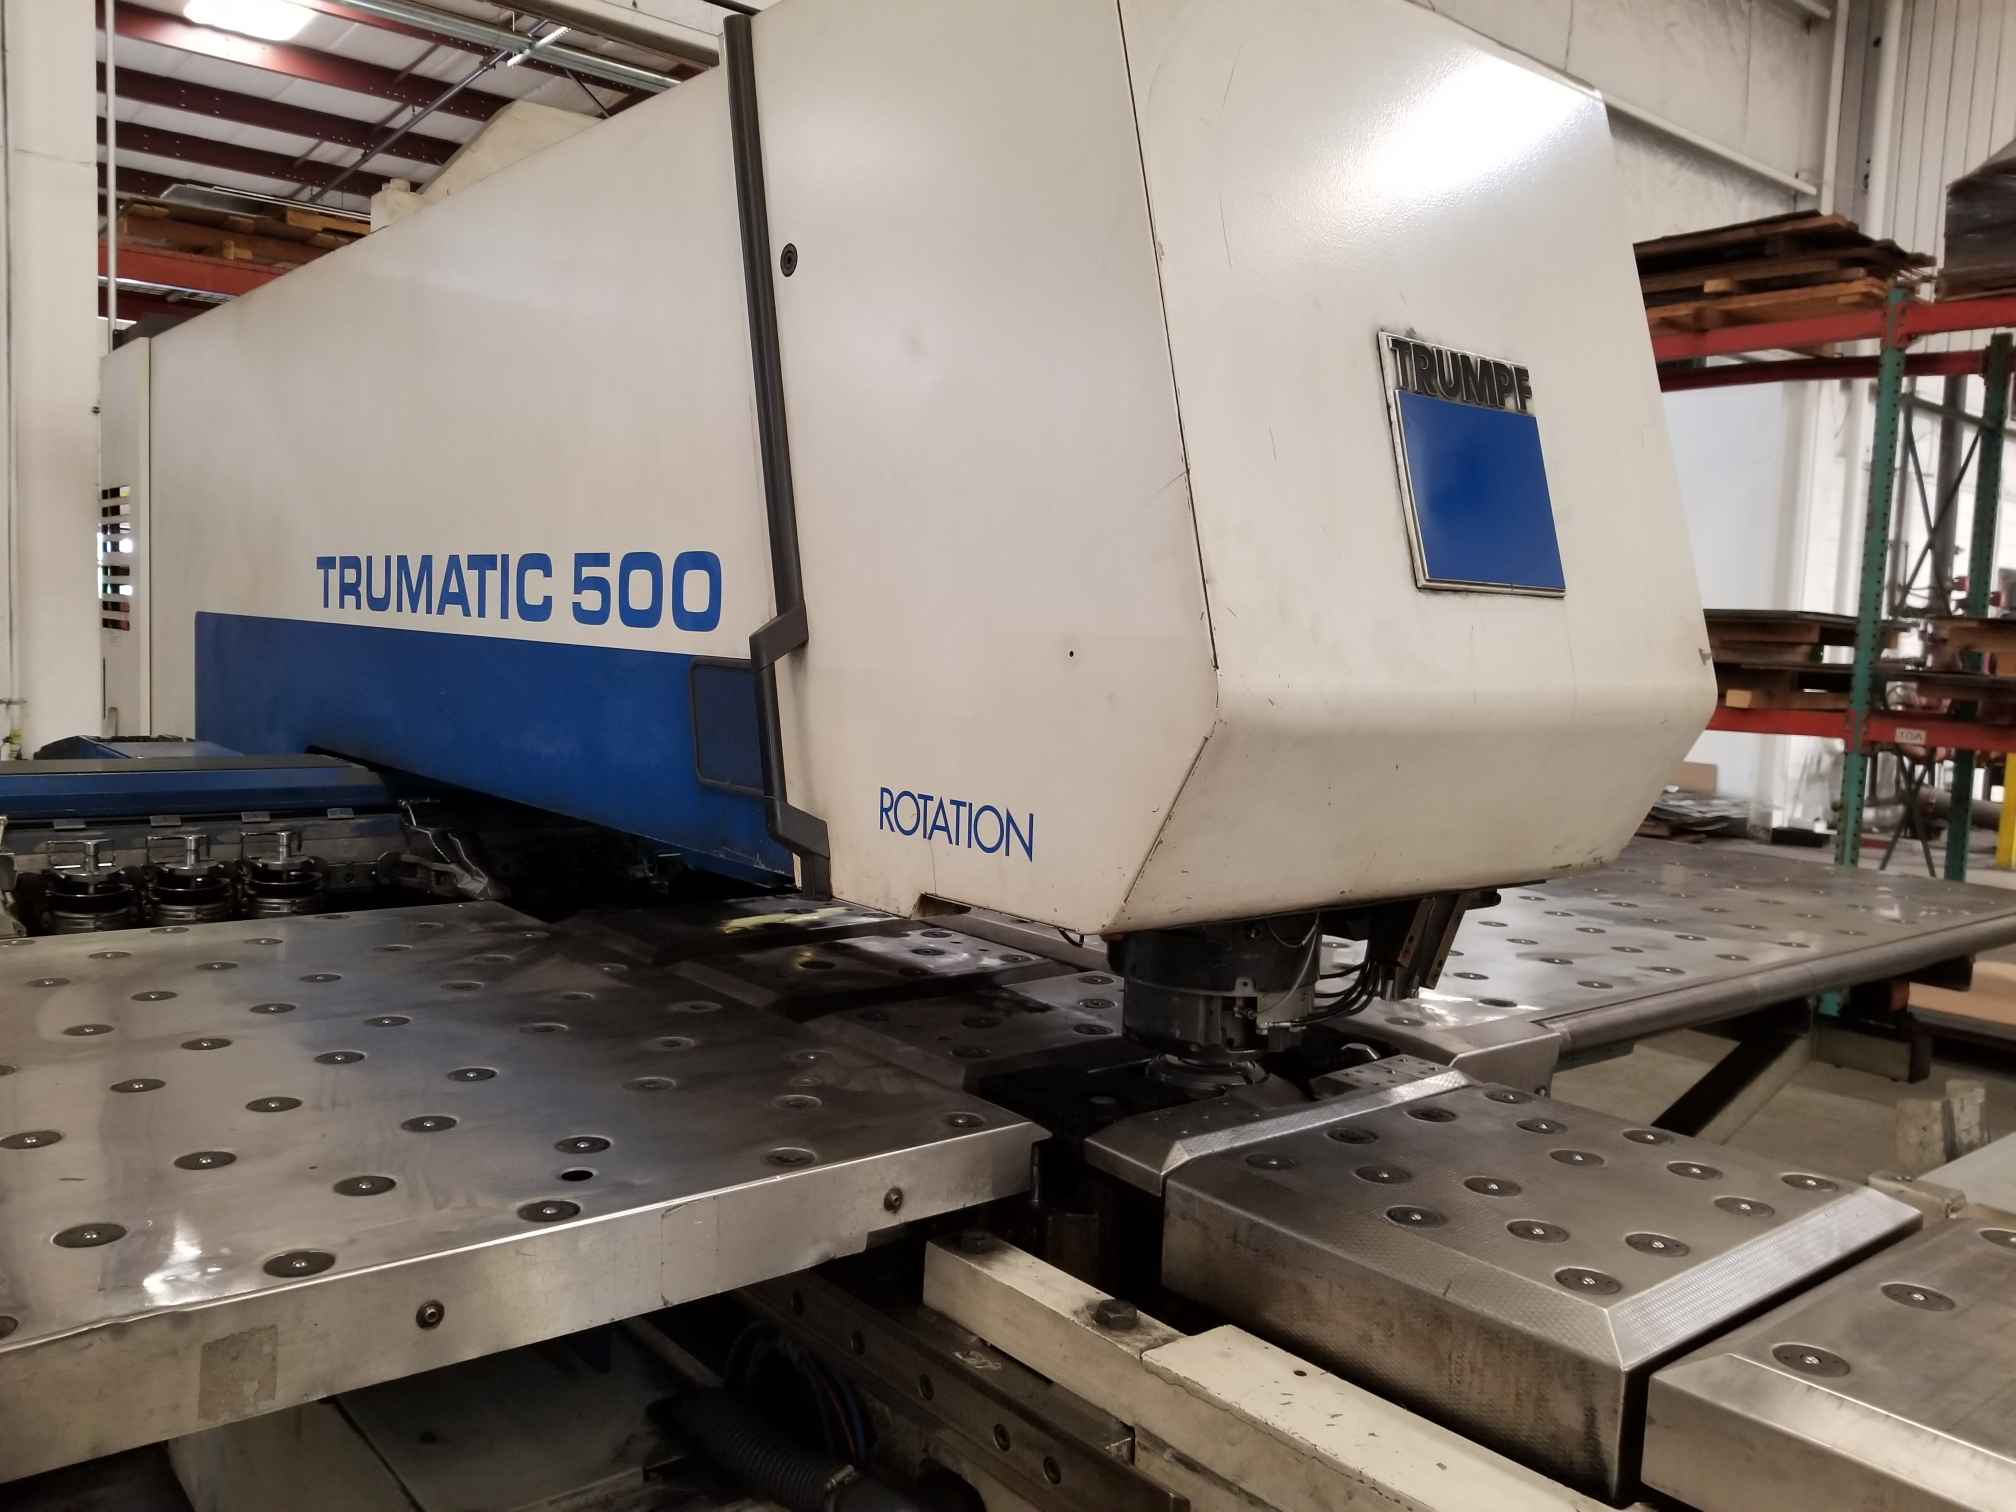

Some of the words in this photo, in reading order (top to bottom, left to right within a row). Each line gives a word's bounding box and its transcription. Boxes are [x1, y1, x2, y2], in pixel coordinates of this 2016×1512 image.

[1390, 338, 1532, 413] TRUMPF
[316, 553, 552, 622] TRUMATIC
[572, 550, 722, 632] 500
[879, 786, 1034, 863] ROTATION
